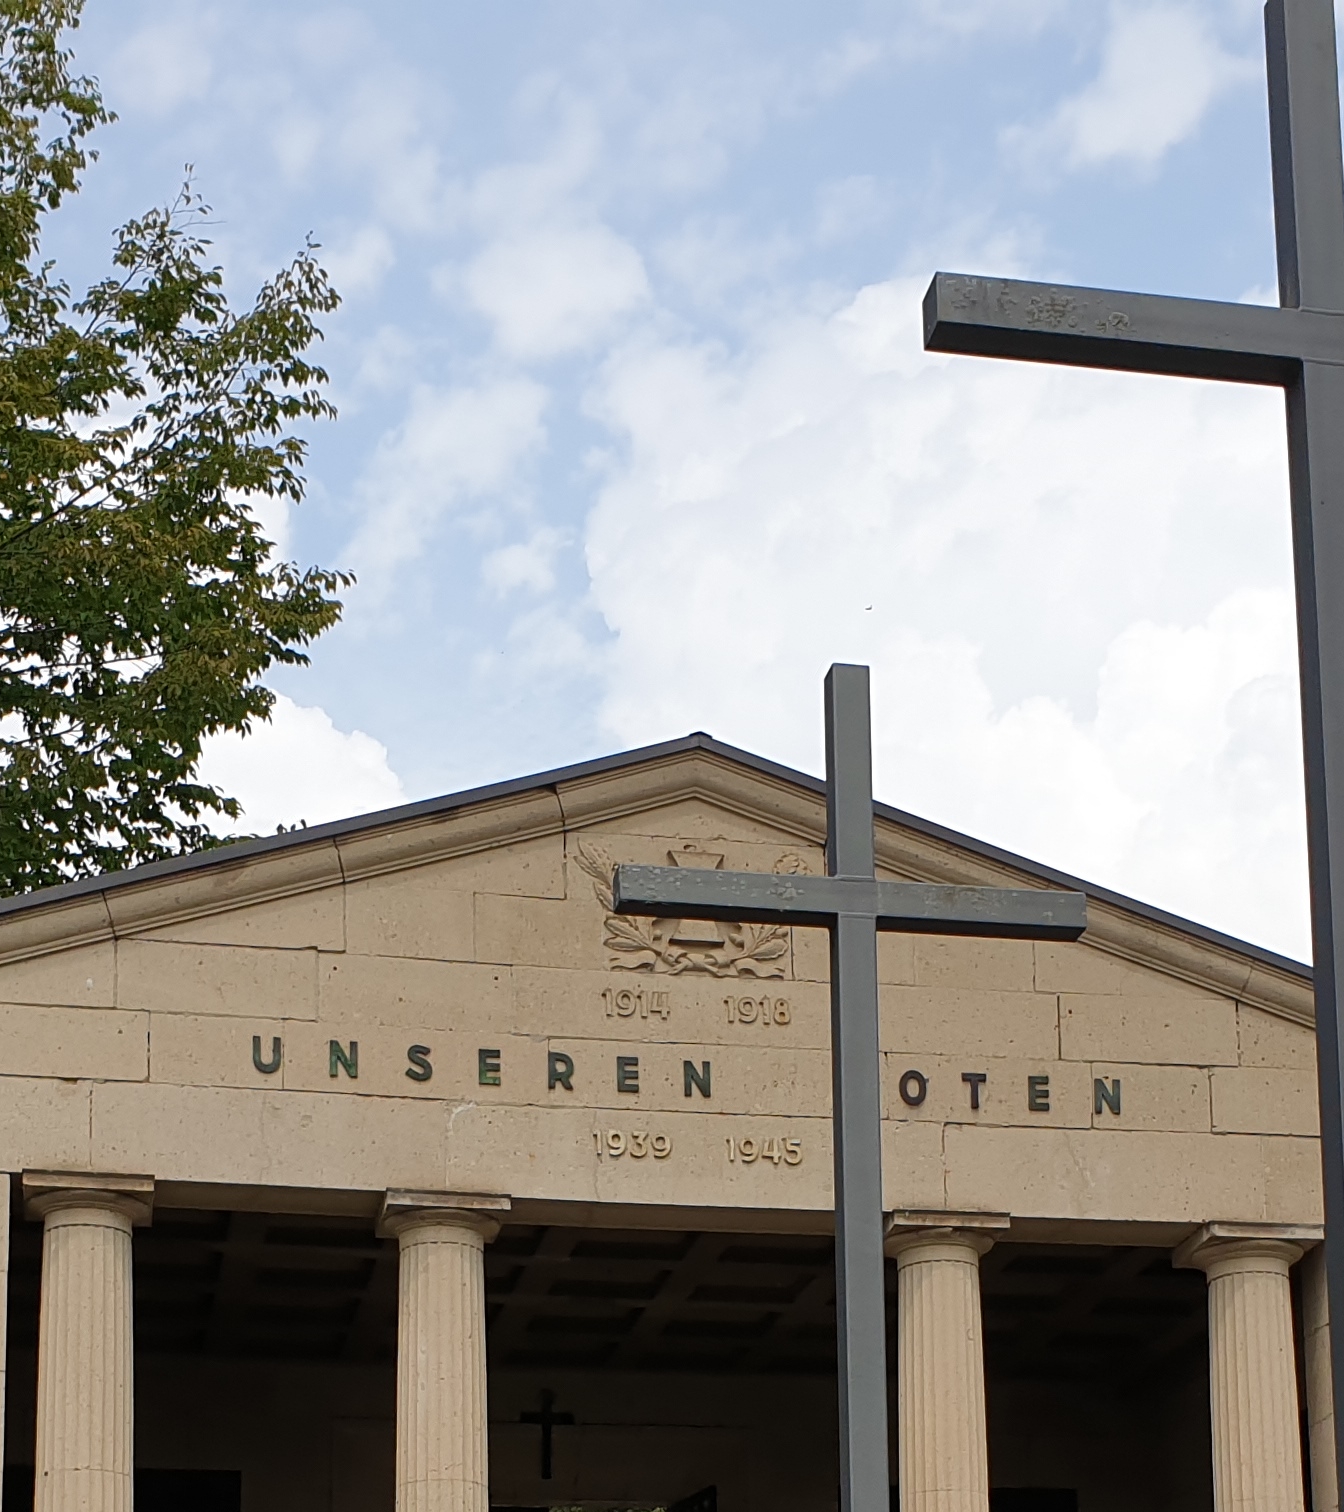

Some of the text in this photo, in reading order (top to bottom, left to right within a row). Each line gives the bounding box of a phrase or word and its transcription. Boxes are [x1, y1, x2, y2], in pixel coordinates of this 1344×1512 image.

[601, 988, 791, 1025] 1914 1918
[252, 1035, 1121, 1116] UNSEREN OTEN
[592, 1129, 803, 1165] 1939 1945
